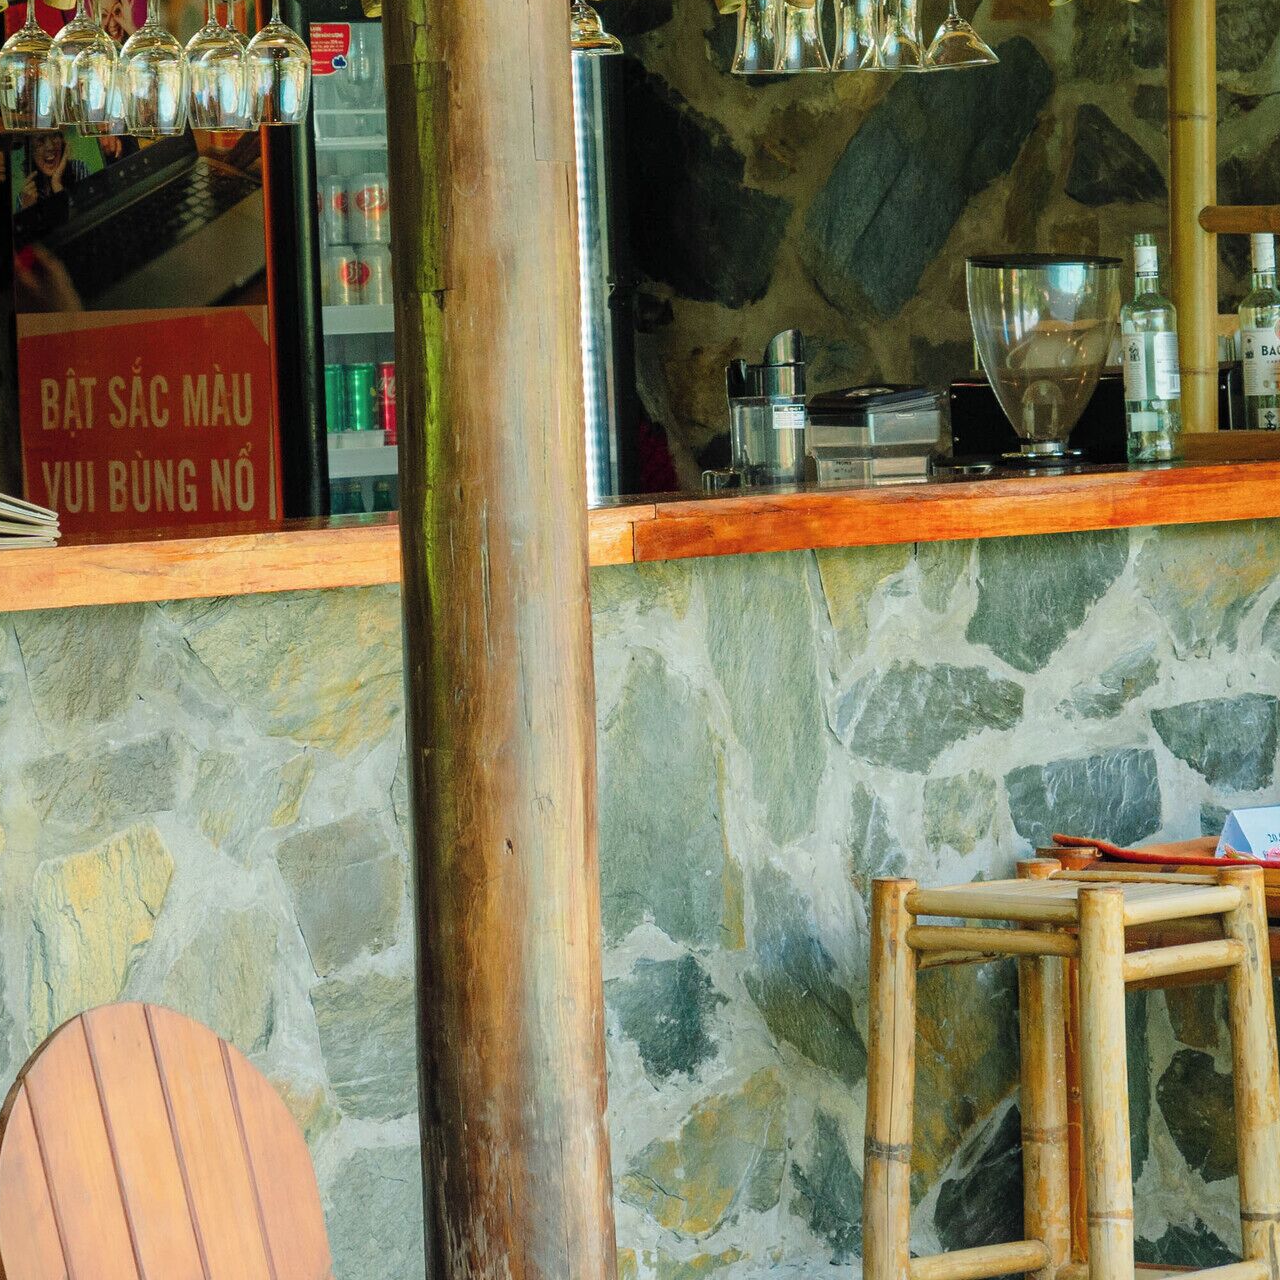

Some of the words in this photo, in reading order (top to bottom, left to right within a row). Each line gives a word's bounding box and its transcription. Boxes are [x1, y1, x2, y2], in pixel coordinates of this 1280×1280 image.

[40, 367, 97, 438] BẬT
[108, 357, 169, 429] SẮC
[182, 363, 253, 427] MÀU
[41, 460, 96, 514] VUI
[107, 450, 198, 513] BÙNG
[210, 441, 256, 512] NỔ
